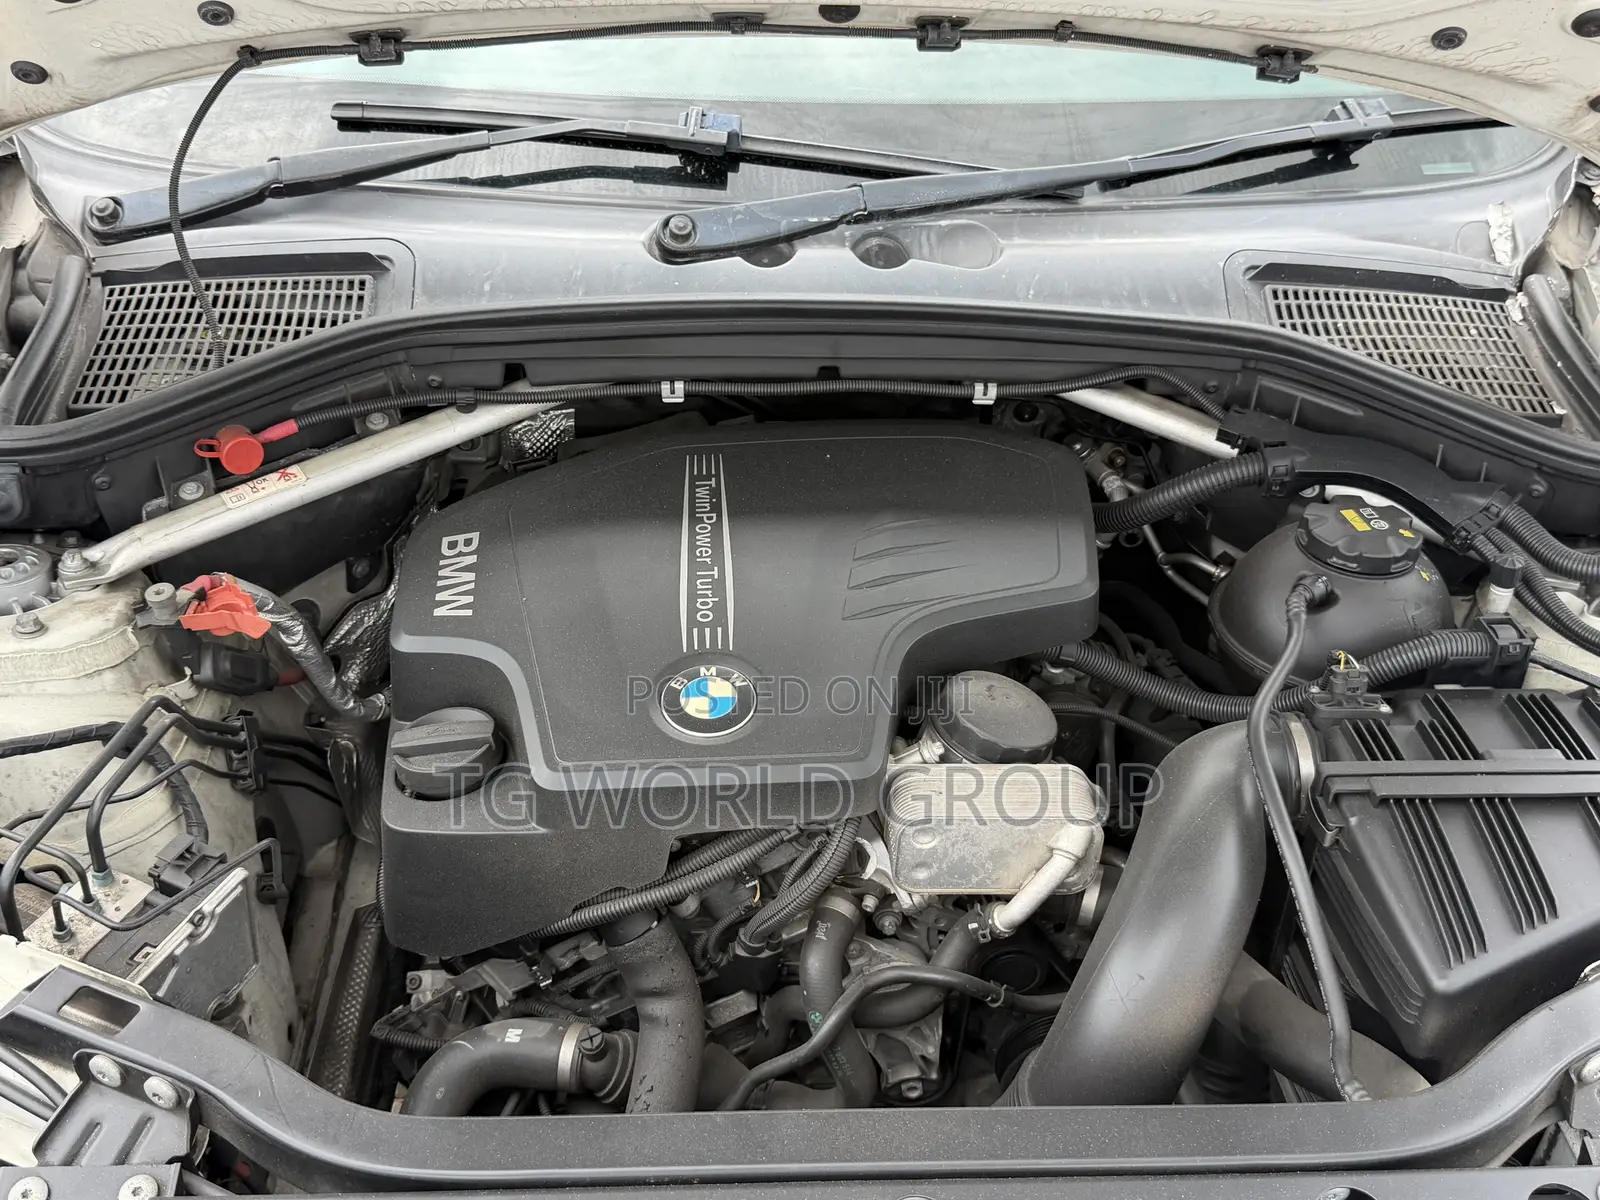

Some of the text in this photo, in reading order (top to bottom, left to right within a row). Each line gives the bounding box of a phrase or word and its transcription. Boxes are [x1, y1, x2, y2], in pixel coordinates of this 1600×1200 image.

[433, 531, 480, 616] BMW
[695, 477, 719, 622] TwinPower Turbo
[669, 666, 748, 690] BMW
